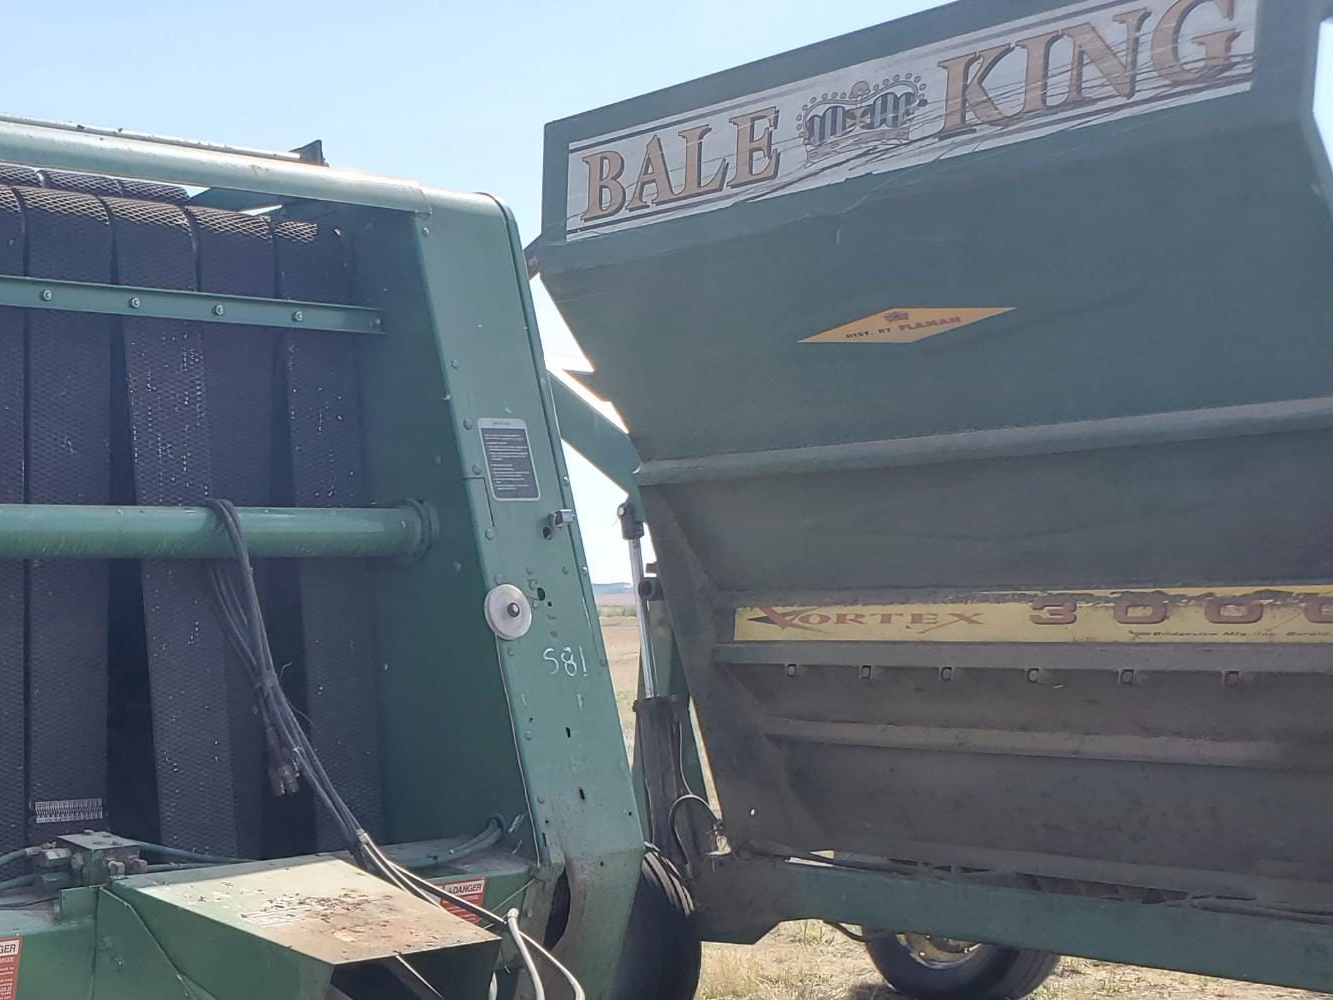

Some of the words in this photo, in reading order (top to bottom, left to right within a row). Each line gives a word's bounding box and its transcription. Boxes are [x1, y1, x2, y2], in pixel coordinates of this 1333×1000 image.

[579, 106, 781, 223] BALE
[937, 0, 1240, 134] KING
[898, 316, 961, 331] FLAMAN
[452, 883, 482, 894] DANGER
